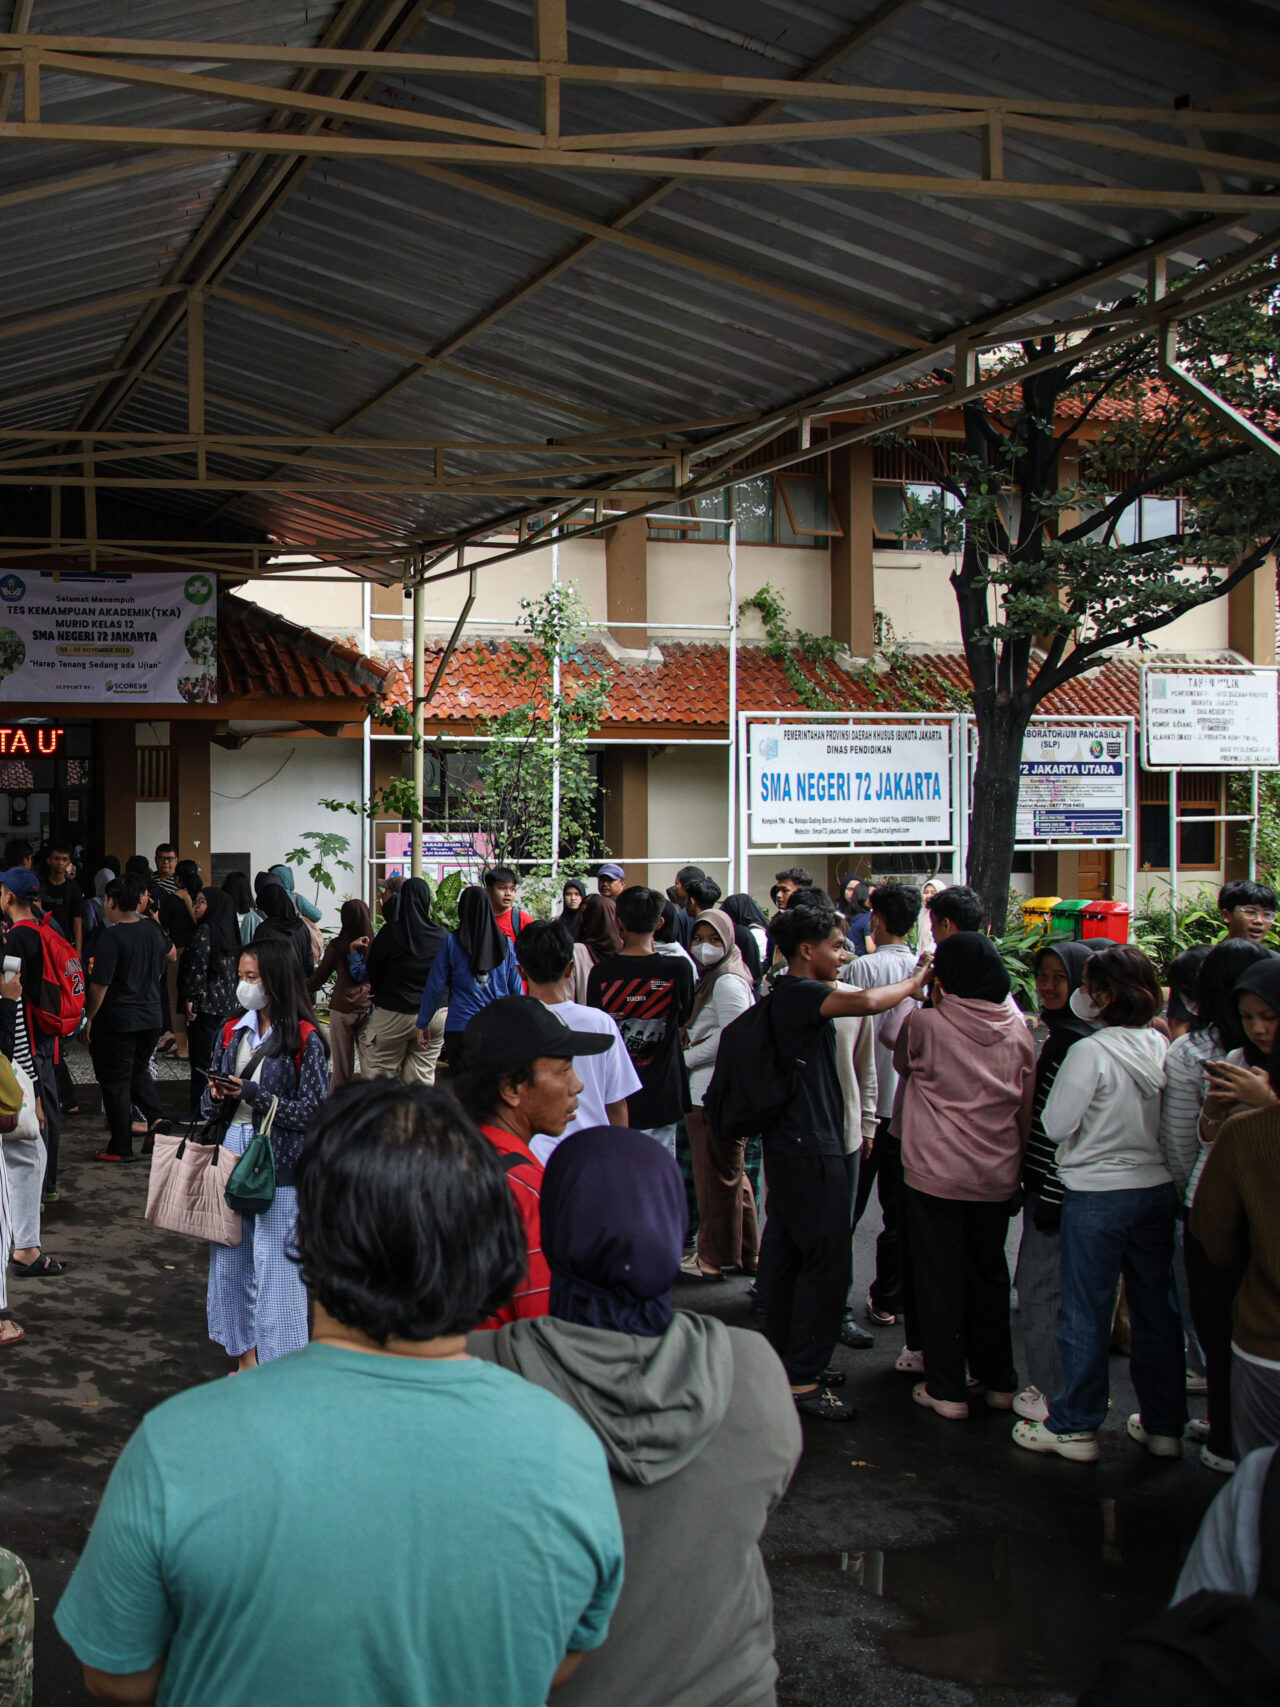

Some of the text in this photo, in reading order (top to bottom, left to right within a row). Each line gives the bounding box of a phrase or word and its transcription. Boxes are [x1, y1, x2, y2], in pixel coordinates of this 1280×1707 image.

[56, 595, 135, 604] Selamat Menempuh
[7, 606, 181, 619] TES KEMAMPUAN AKADEMIK(TKA)
[55, 620, 134, 629] MURID KELAS 12
[32, 630, 158, 643] SMA NEGERI 72 JAKARTA
[58, 660, 87, 670] Tenang
[89, 661, 119, 670] Sedang
[121, 661, 135, 669] ada
[783, 730, 942, 741] PEMERINTAHAN PROVINSI DAERAH KHUSUS IBUKOTA JAKARTA
[1079, 730, 1121, 739] PANCASILA
[37, 728, 64, 753] U
[1041, 740, 1060, 749] (SLP)
[827, 745, 892, 754] DINAS PENDIDIKAN
[1031, 765, 1079, 774] JAKARTA
[1081, 765, 1115, 774] UTARA
[761, 772, 942, 802] SMA NEGERI 72 JAKARTA
